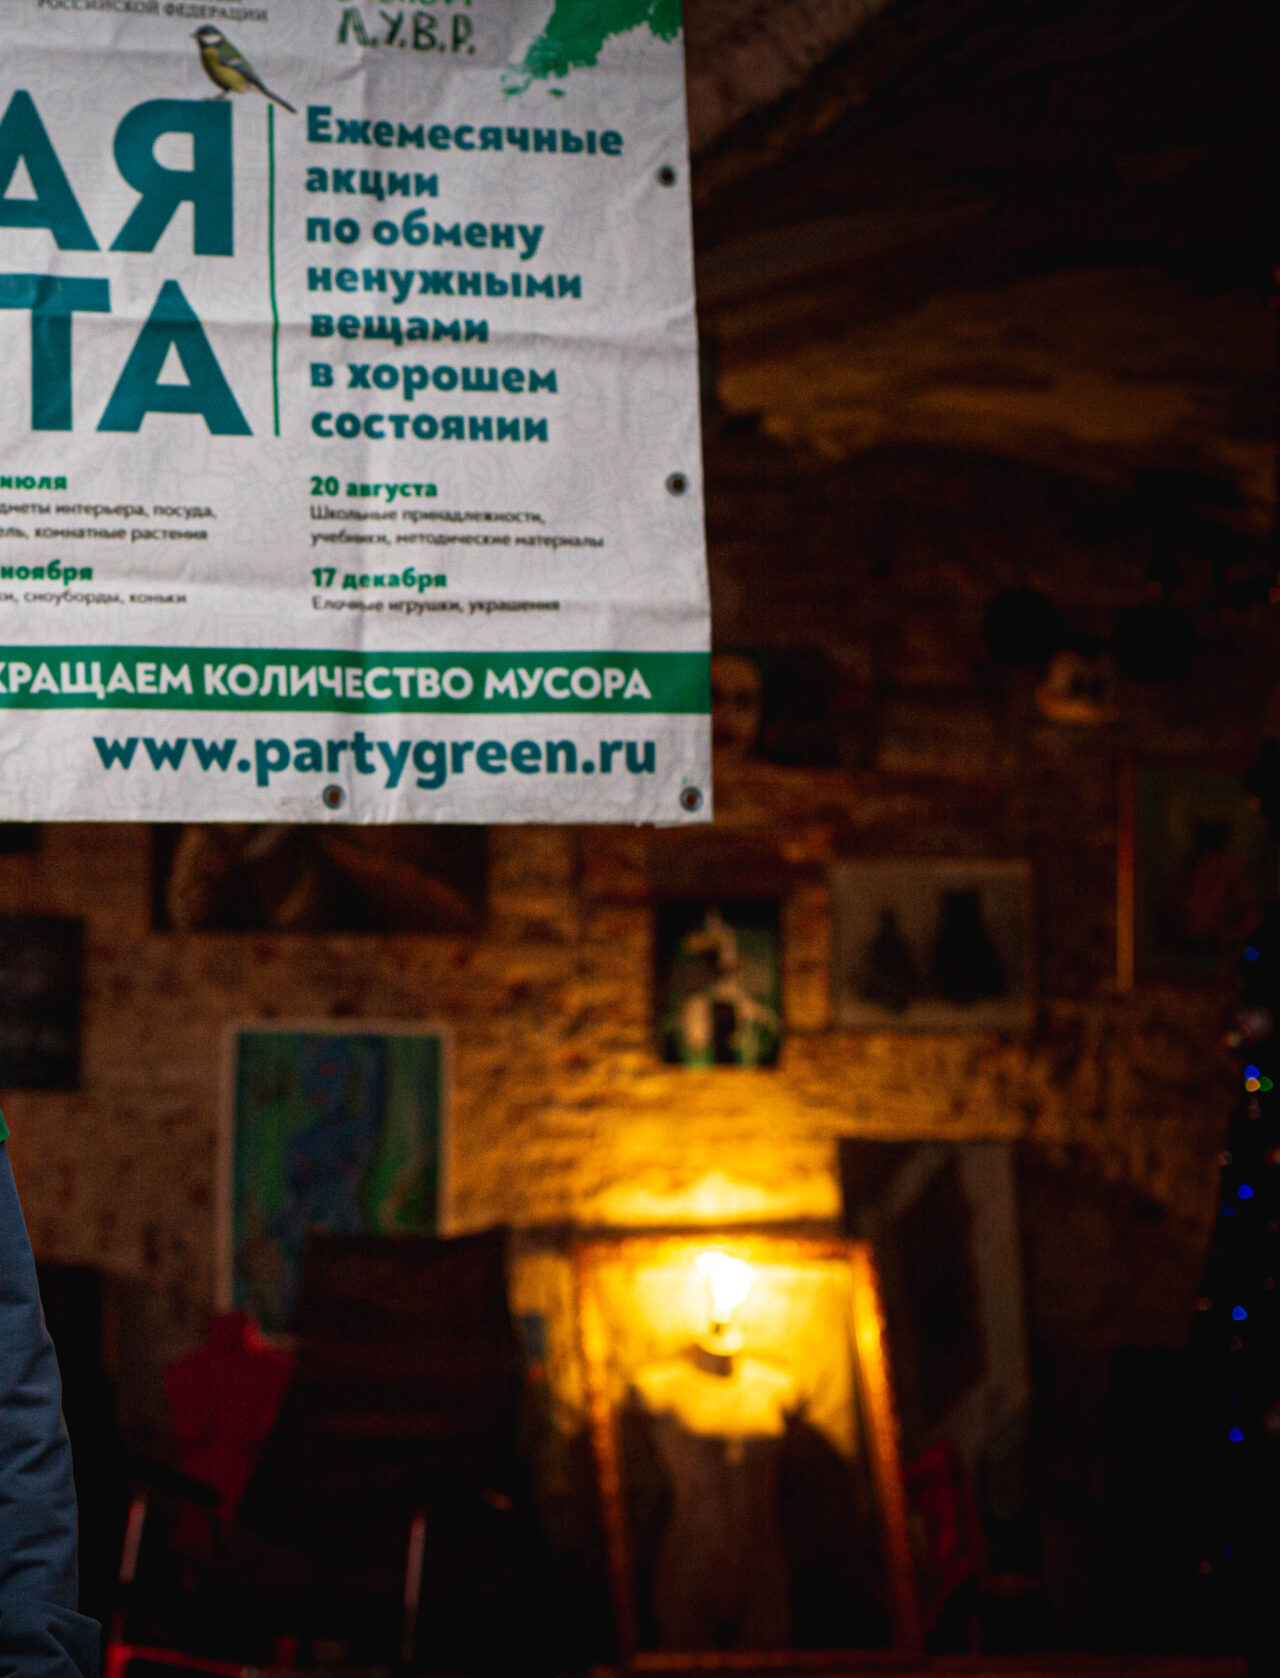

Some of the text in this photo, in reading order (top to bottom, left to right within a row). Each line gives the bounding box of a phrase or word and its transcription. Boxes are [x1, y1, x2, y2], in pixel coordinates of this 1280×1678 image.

[163, 4, 268, 22] ФЕДЕРАЦИИ
[306, 105, 624, 156] Ежемесячные
[305, 166, 439, 201] акции
[306, 207, 545, 260] по обмену
[307, 266, 582, 304] ненужными
[310, 313, 489, 346] вещами
[310, 362, 558, 401] в хорошем
[311, 411, 549, 442] состоянии
[0, 474, 68, 490] июля
[309, 475, 438, 503] 20 августа
[55, 501, 149, 519] интерьера,
[153, 503, 217, 520] посуда,
[309, 505, 547, 525] Школьные принадлежности,
[34, 526, 126, 541] комнатные
[130, 527, 208, 543] растения
[310, 529, 605, 550] учебники, методические материалы
[0, 559, 93, 587] ноября
[311, 566, 448, 593] 17 декабря
[23, 589, 124, 606] сноуборды,
[129, 592, 187, 604] коньки
[388, 599, 464, 616] игрушки,
[470, 600, 561, 615] украшения
[204, 663, 474, 699] КОЛИЧЕСТВО
[484, 667, 652, 699] МУСОРА
[93, 731, 656, 790] www.partygreen.ru
